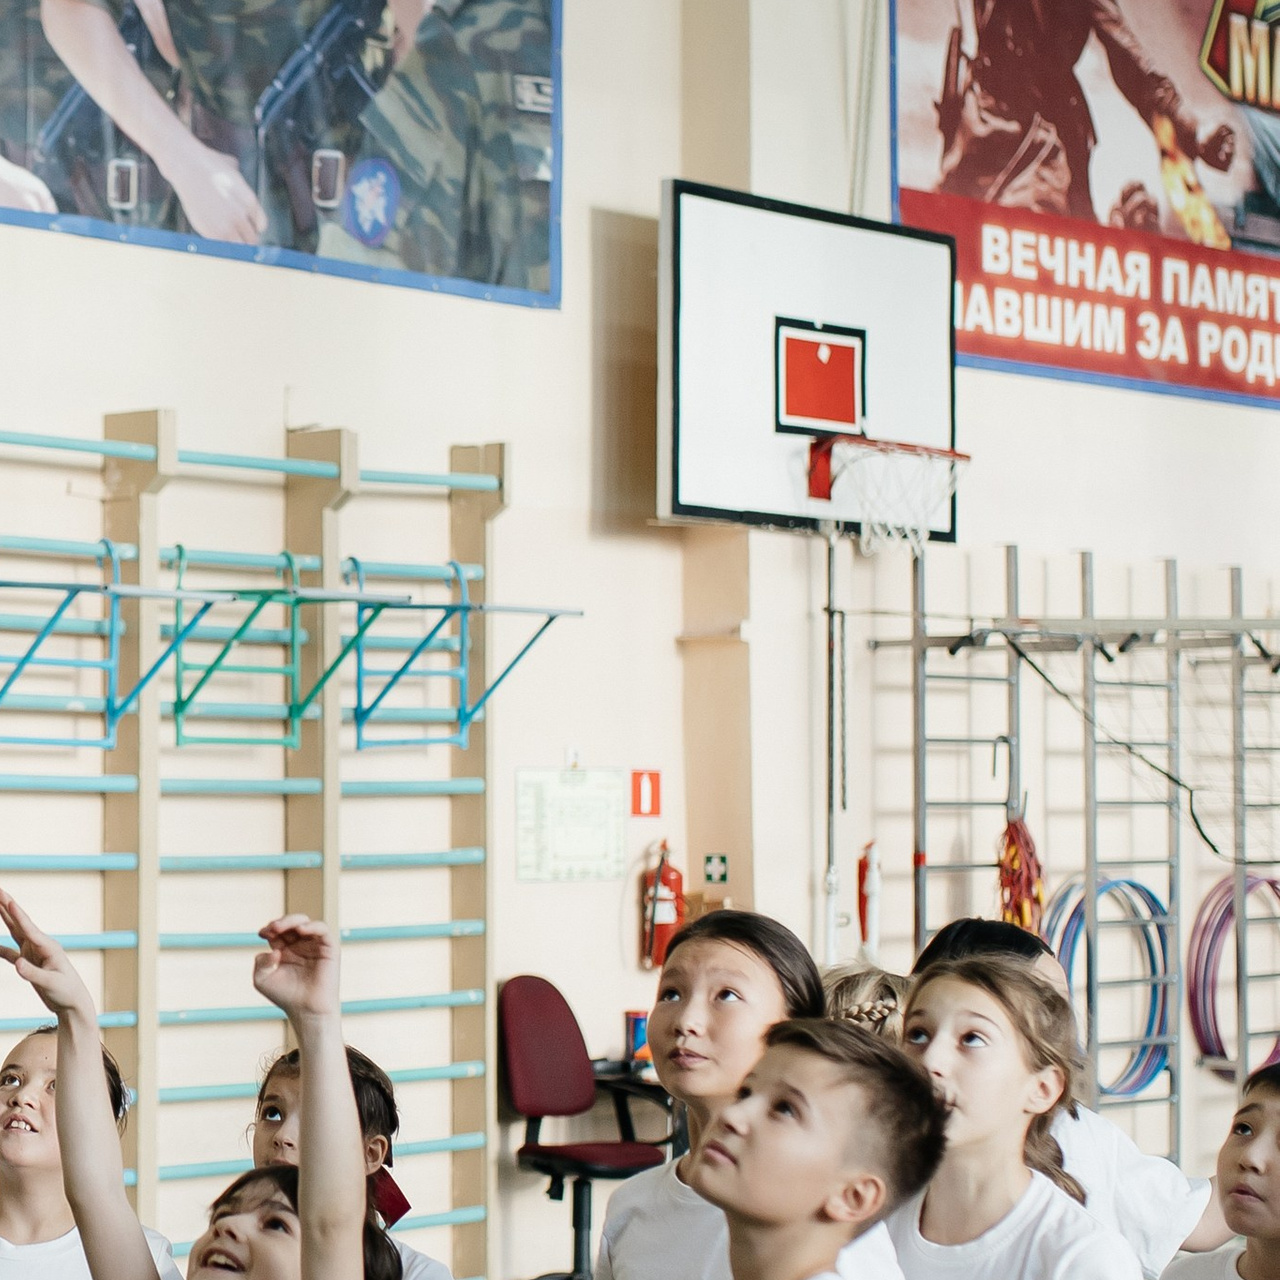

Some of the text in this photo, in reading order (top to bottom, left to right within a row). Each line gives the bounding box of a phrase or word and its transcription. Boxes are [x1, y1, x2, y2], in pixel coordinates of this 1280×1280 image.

[981, 223, 1151, 301] ВЕЧНАЯ
[1136, 311, 1189, 365] ЗА
[1198, 320, 1280, 387] РОД
